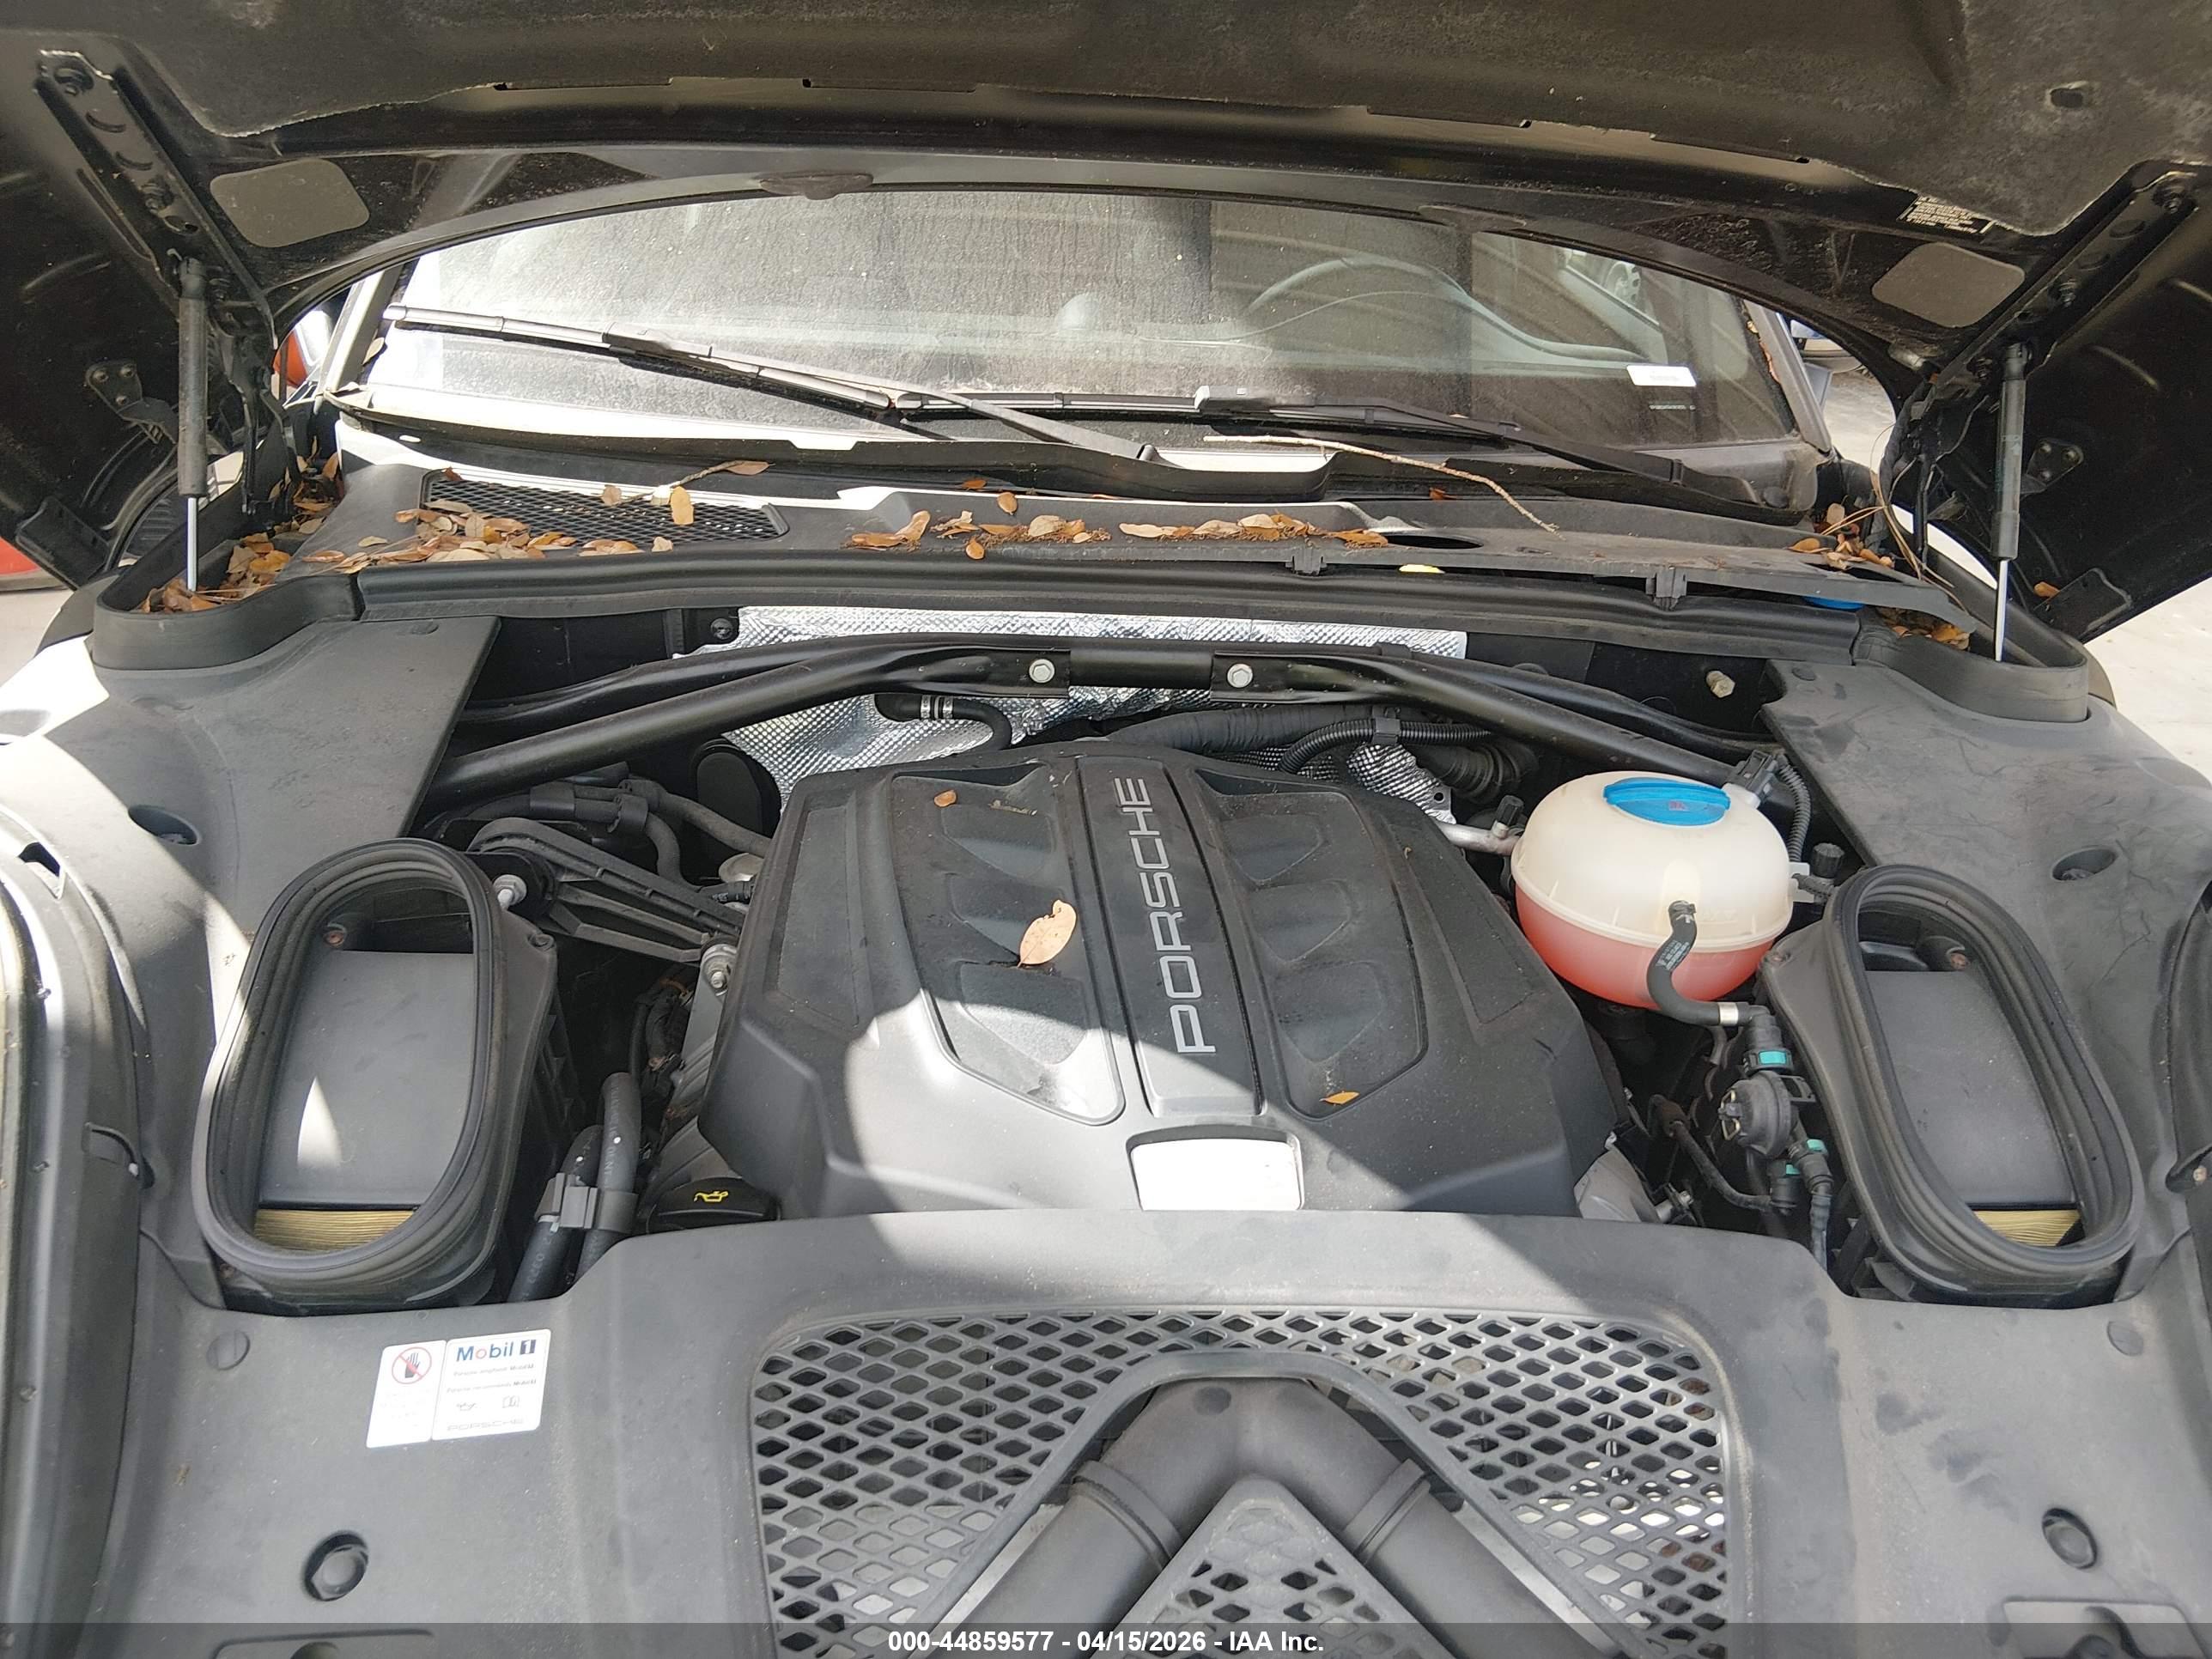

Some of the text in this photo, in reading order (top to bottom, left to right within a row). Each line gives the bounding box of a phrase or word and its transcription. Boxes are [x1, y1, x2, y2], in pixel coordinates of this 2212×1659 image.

[1114, 777, 1216, 1054] PORSCHE
[456, 1340, 537, 1362] Mobil 1
